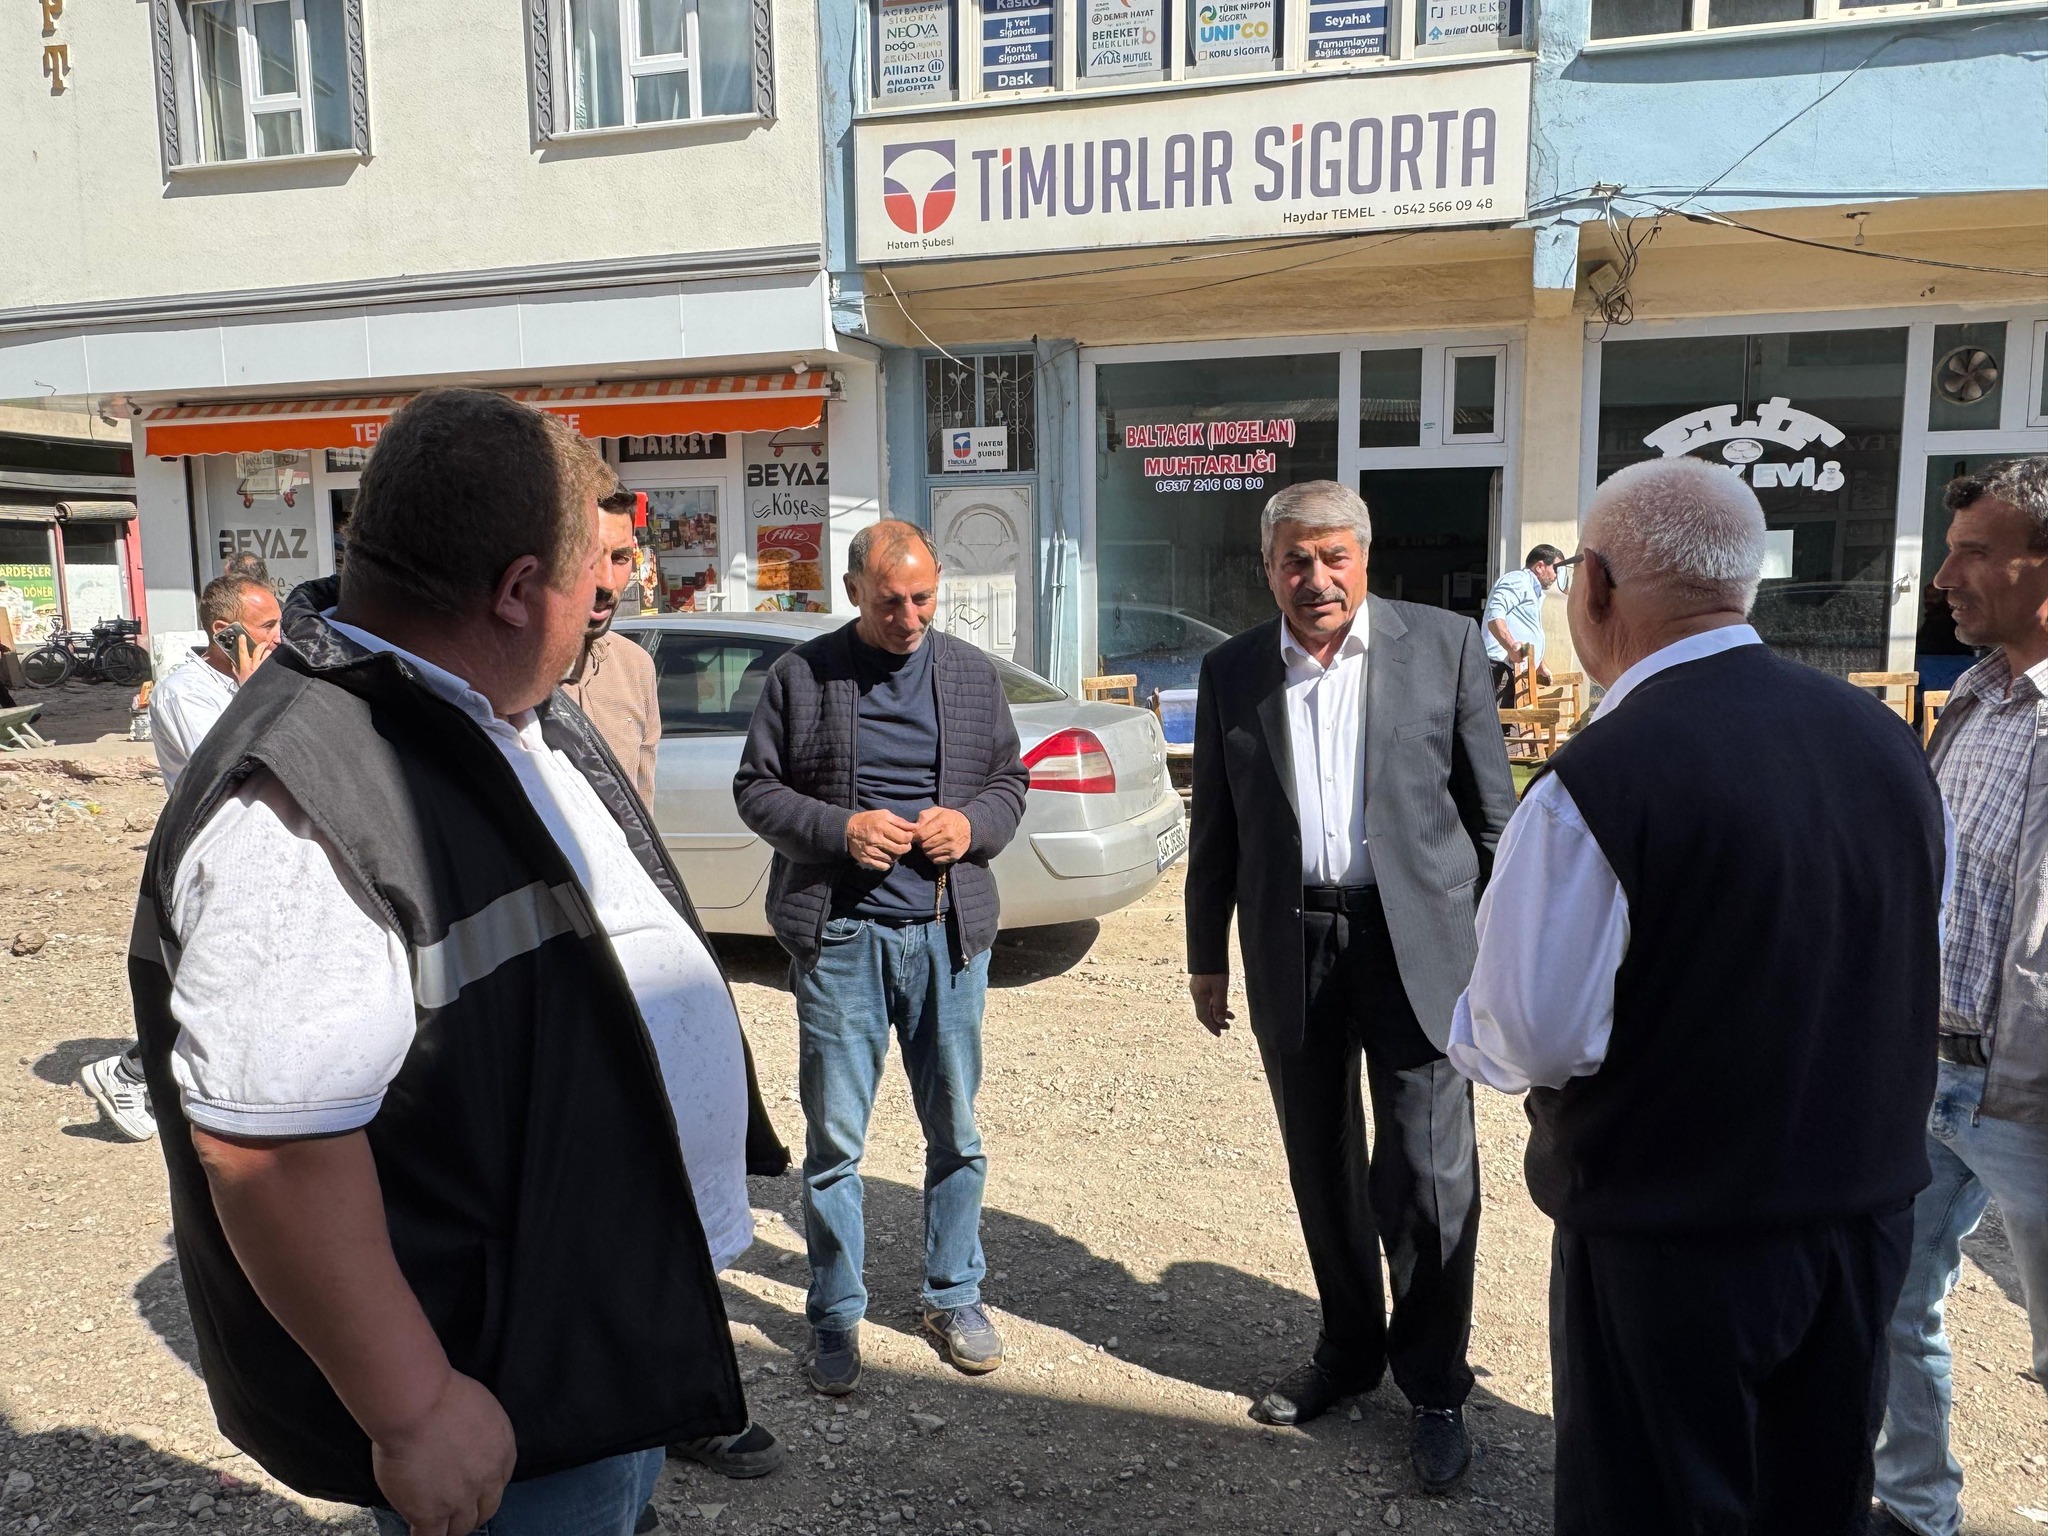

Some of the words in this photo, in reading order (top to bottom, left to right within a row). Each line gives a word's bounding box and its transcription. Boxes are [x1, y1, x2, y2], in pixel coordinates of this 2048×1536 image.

[882, 3, 943, 17] ACIBADEM
[1130, 9, 1154, 18] HAYAT
[1451, 1, 1507, 16] EUREKO
[1324, 13, 1371, 27] Seyahat
[887, 23, 938, 39] NEOVA
[1092, 27, 1140, 41] BEREKET
[1470, 22, 1503, 33] QUICK
[1005, 44, 1032, 55] Konut
[1209, 50, 1232, 59] KORU
[1123, 52, 1152, 63] MUTUEL
[883, 64, 925, 76] Allianz
[886, 75, 942, 86] ANADOLU
[997, 71, 1034, 87] Dask
[971, 130, 1233, 222] TİMURLAR
[1254, 107, 1497, 202] SİGORTA
[1283, 210, 1328, 224] Haydar
[1331, 206, 1375, 220] TEMEL
[1394, 203, 1425, 216] 0542
[1428, 201, 1452, 213] 566
[1455, 199, 1473, 211] 09
[1476, 198, 1494, 209] 48
[887, 241, 919, 250] Hatem
[1126, 423, 1205, 448] BALTACIK
[1207, 418, 1296, 451] (MOZELAN)
[628, 432, 714, 456] MARKET
[1144, 449, 1276, 477] MUHTARLIĞI
[747, 462, 829, 487] BEYAZ
[1156, 479, 1191, 492] 0537
[1193, 478, 1221, 492] 216
[1223, 477, 1242, 491] 03
[1245, 477, 1264, 491] 90
[772, 493, 809, 520] Köşe
[219, 528, 309, 559] BEYAZ
[23, 584, 53, 598] DÖNER
